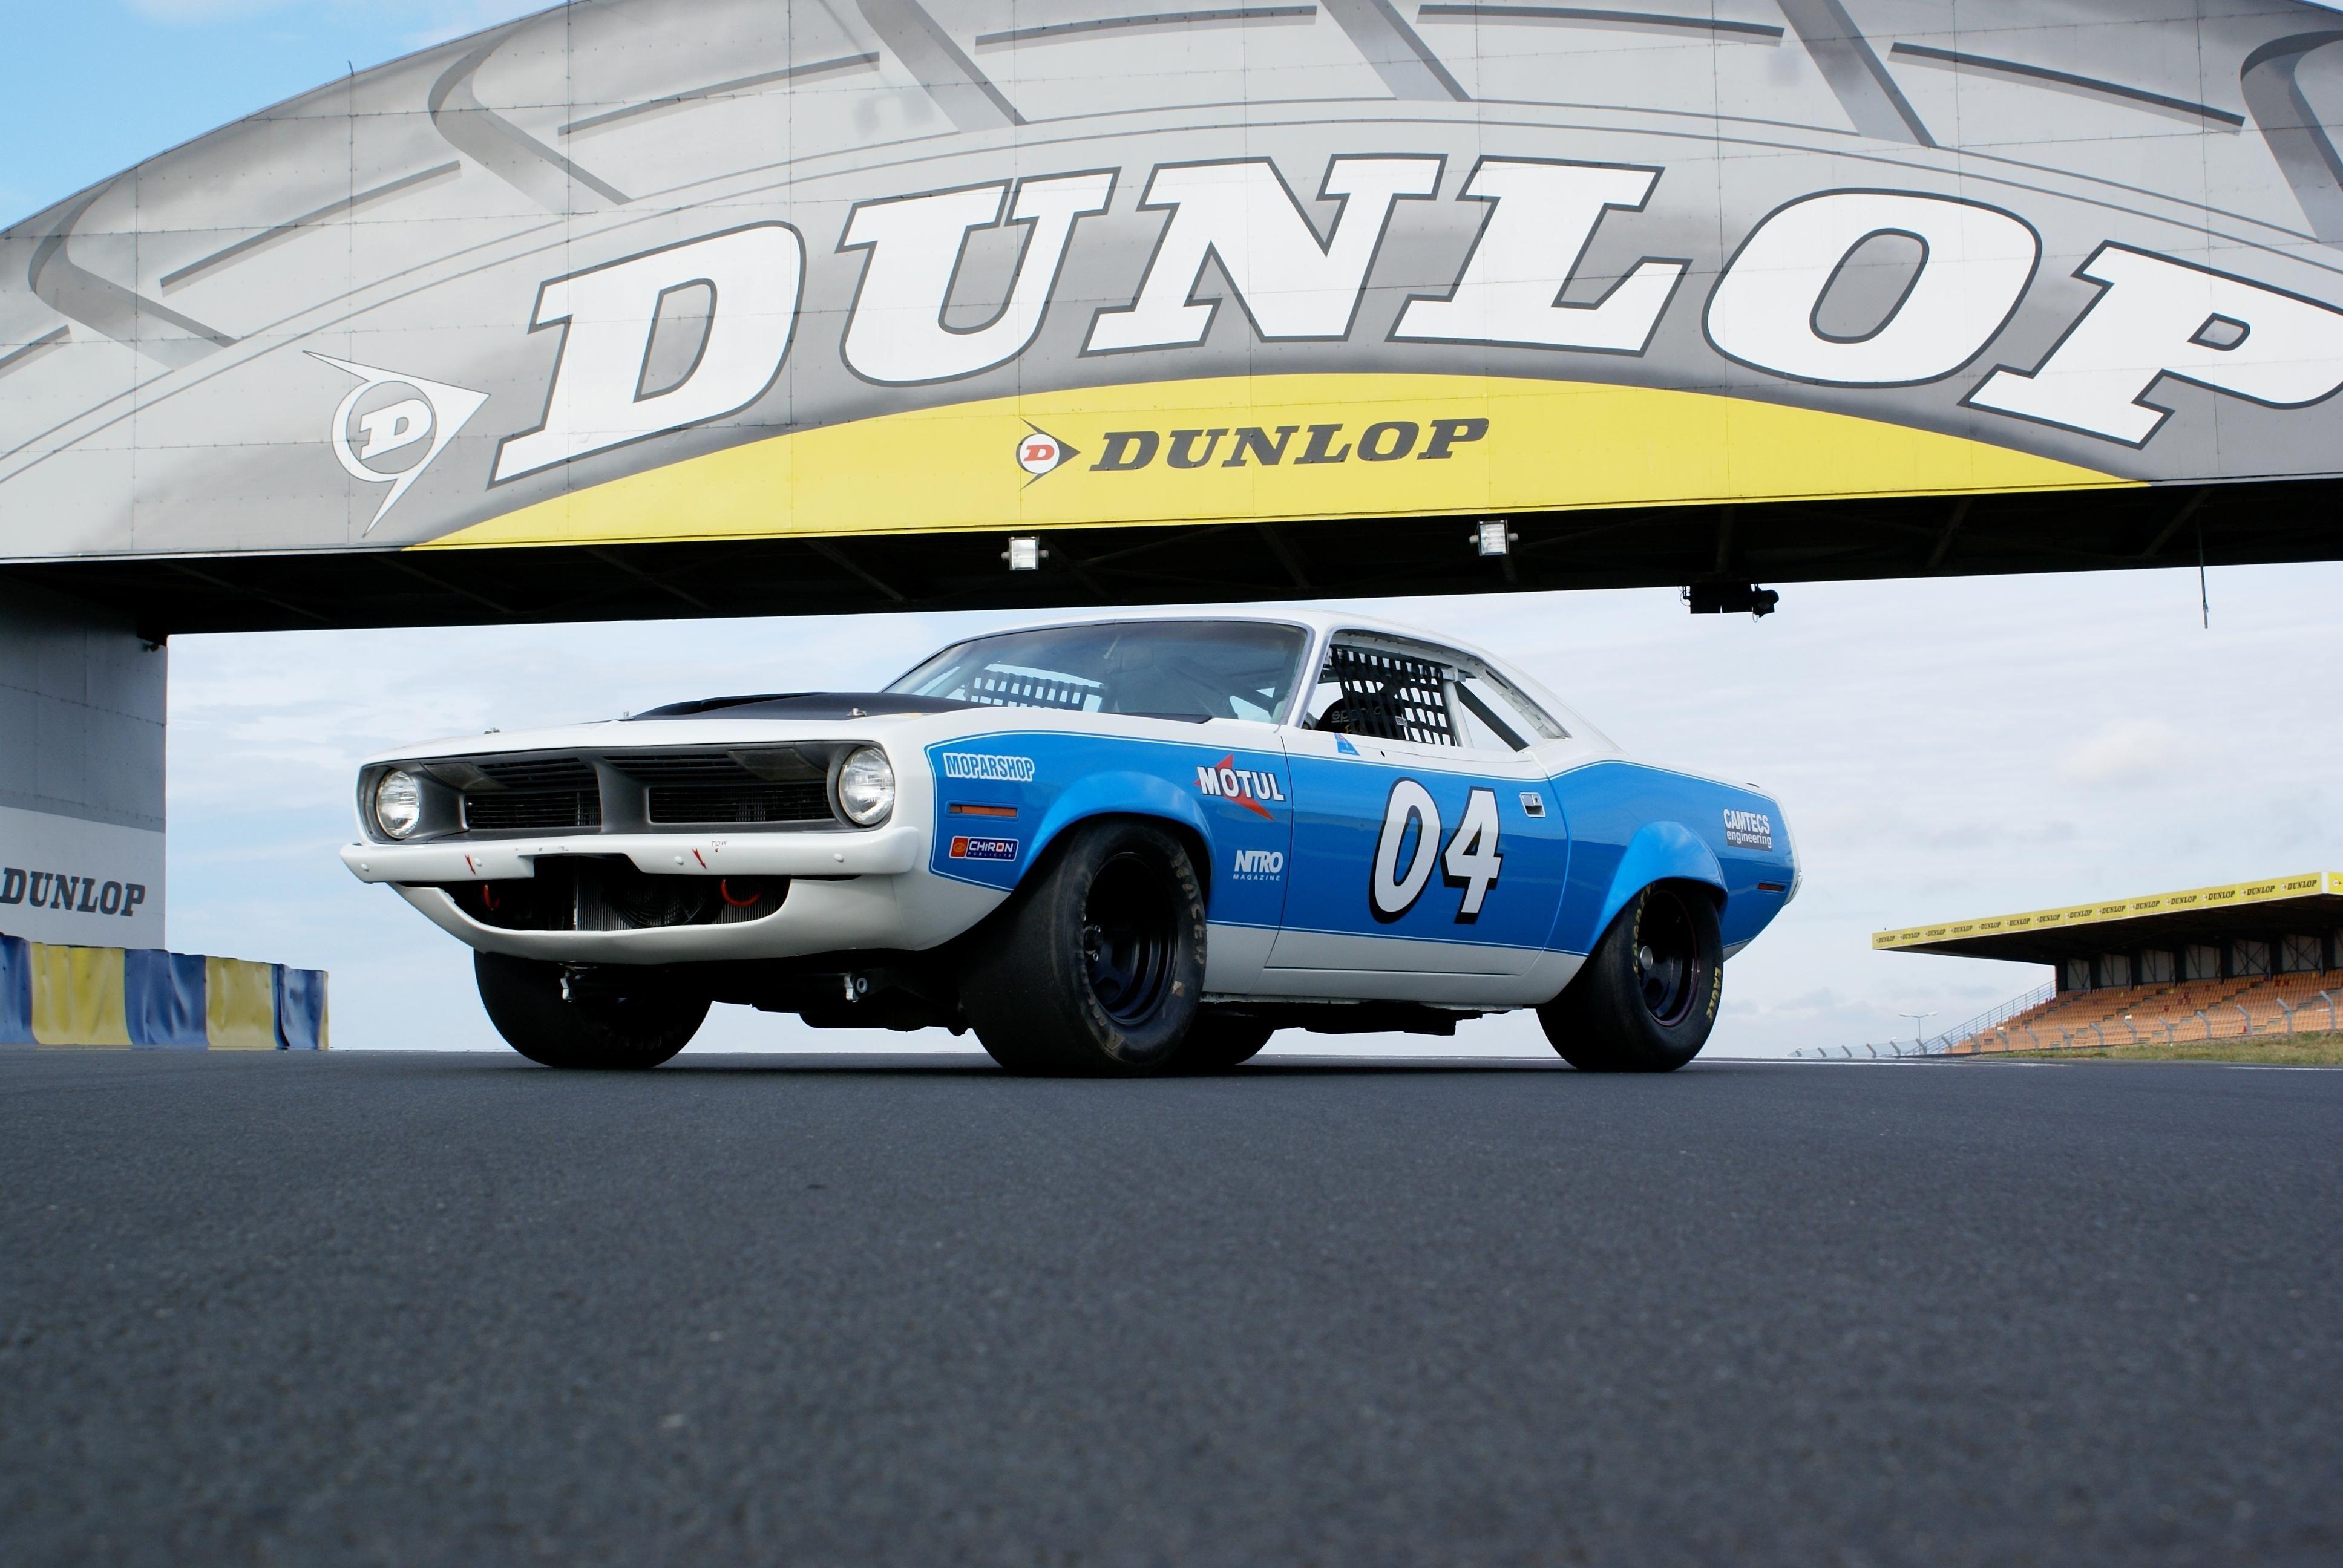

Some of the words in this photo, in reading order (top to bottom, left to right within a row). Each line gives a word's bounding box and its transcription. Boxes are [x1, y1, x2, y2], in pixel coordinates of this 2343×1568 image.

[359, 399, 433, 461] D
[487, 154, 2343, 490] DUNLOP
[1024, 445, 1055, 462] D
[1089, 417, 1489, 472] DUNLOP
[944, 754, 1034, 780] MOPARSHOP
[1196, 766, 1285, 801] MOTUL
[1723, 809, 1770, 834] CAMTECS
[969, 841, 1014, 852] CHIRON
[1370, 778, 1503, 923] 04
[1726, 830, 1772, 848] engineering
[1234, 850, 1283, 873] NITRO
[0, 867, 145, 916] DUNLOP
[2102, 906, 2126, 914] DUNLOP
[2135, 900, 2160, 909] DUNLOP
[2171, 895, 2197, 904] DUNLOP
[2208, 890, 2235, 900] DUNLOP
[2247, 885, 2275, 895] DUNLOP
[2287, 880, 2317, 890] DUNLOP
